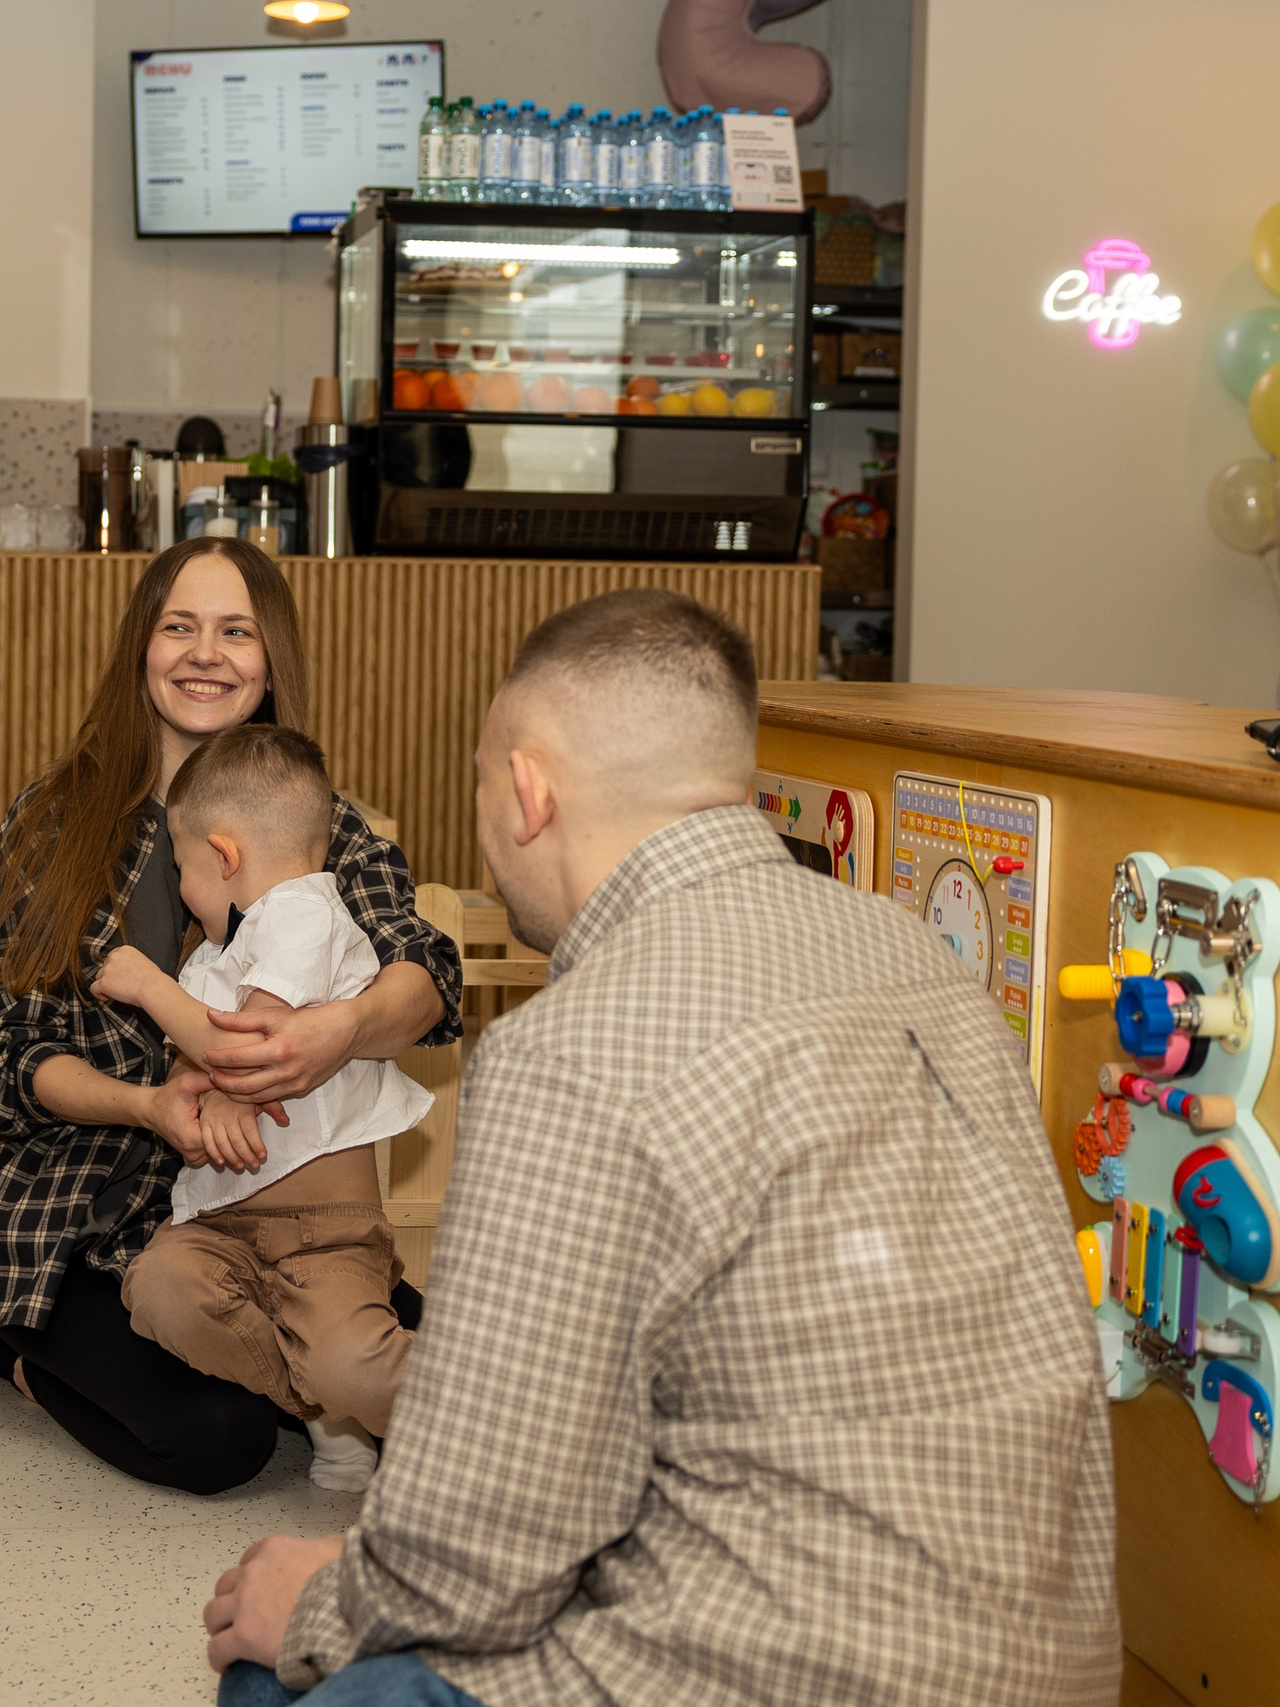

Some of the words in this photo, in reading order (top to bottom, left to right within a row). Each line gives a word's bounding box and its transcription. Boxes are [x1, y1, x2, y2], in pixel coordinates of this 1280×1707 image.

[1041, 269, 1182, 336] Coffee
[972, 809, 978, 819] 10
[989, 812, 995, 824] 12
[998, 814, 1004, 825] 13
[1007, 816, 1014, 828] 14
[1017, 818, 1023, 830] 15
[1026, 820, 1033, 832] 16
[901, 814, 907, 824] 17
[909, 816, 914, 826] 18
[917, 817, 923, 828] 19
[924, 819, 931, 830] 20
[933, 821, 938, 832] 21
[941, 823, 947, 834] 22
[949, 825, 956, 836] 23
[974, 831, 981, 842] 26
[983, 833, 990, 844] 27
[992, 835, 1000, 846] 28
[1001, 836, 1009, 848] 29
[1010, 839, 1018, 850] 30
[1021, 841, 1028, 852] 31
[942, 884, 949, 905] 11
[953, 879, 962, 899] 12
[967, 889, 971, 911] 1
[933, 907, 942, 925] 10
[974, 910, 980, 930] 2
[977, 940, 983, 960] 3
